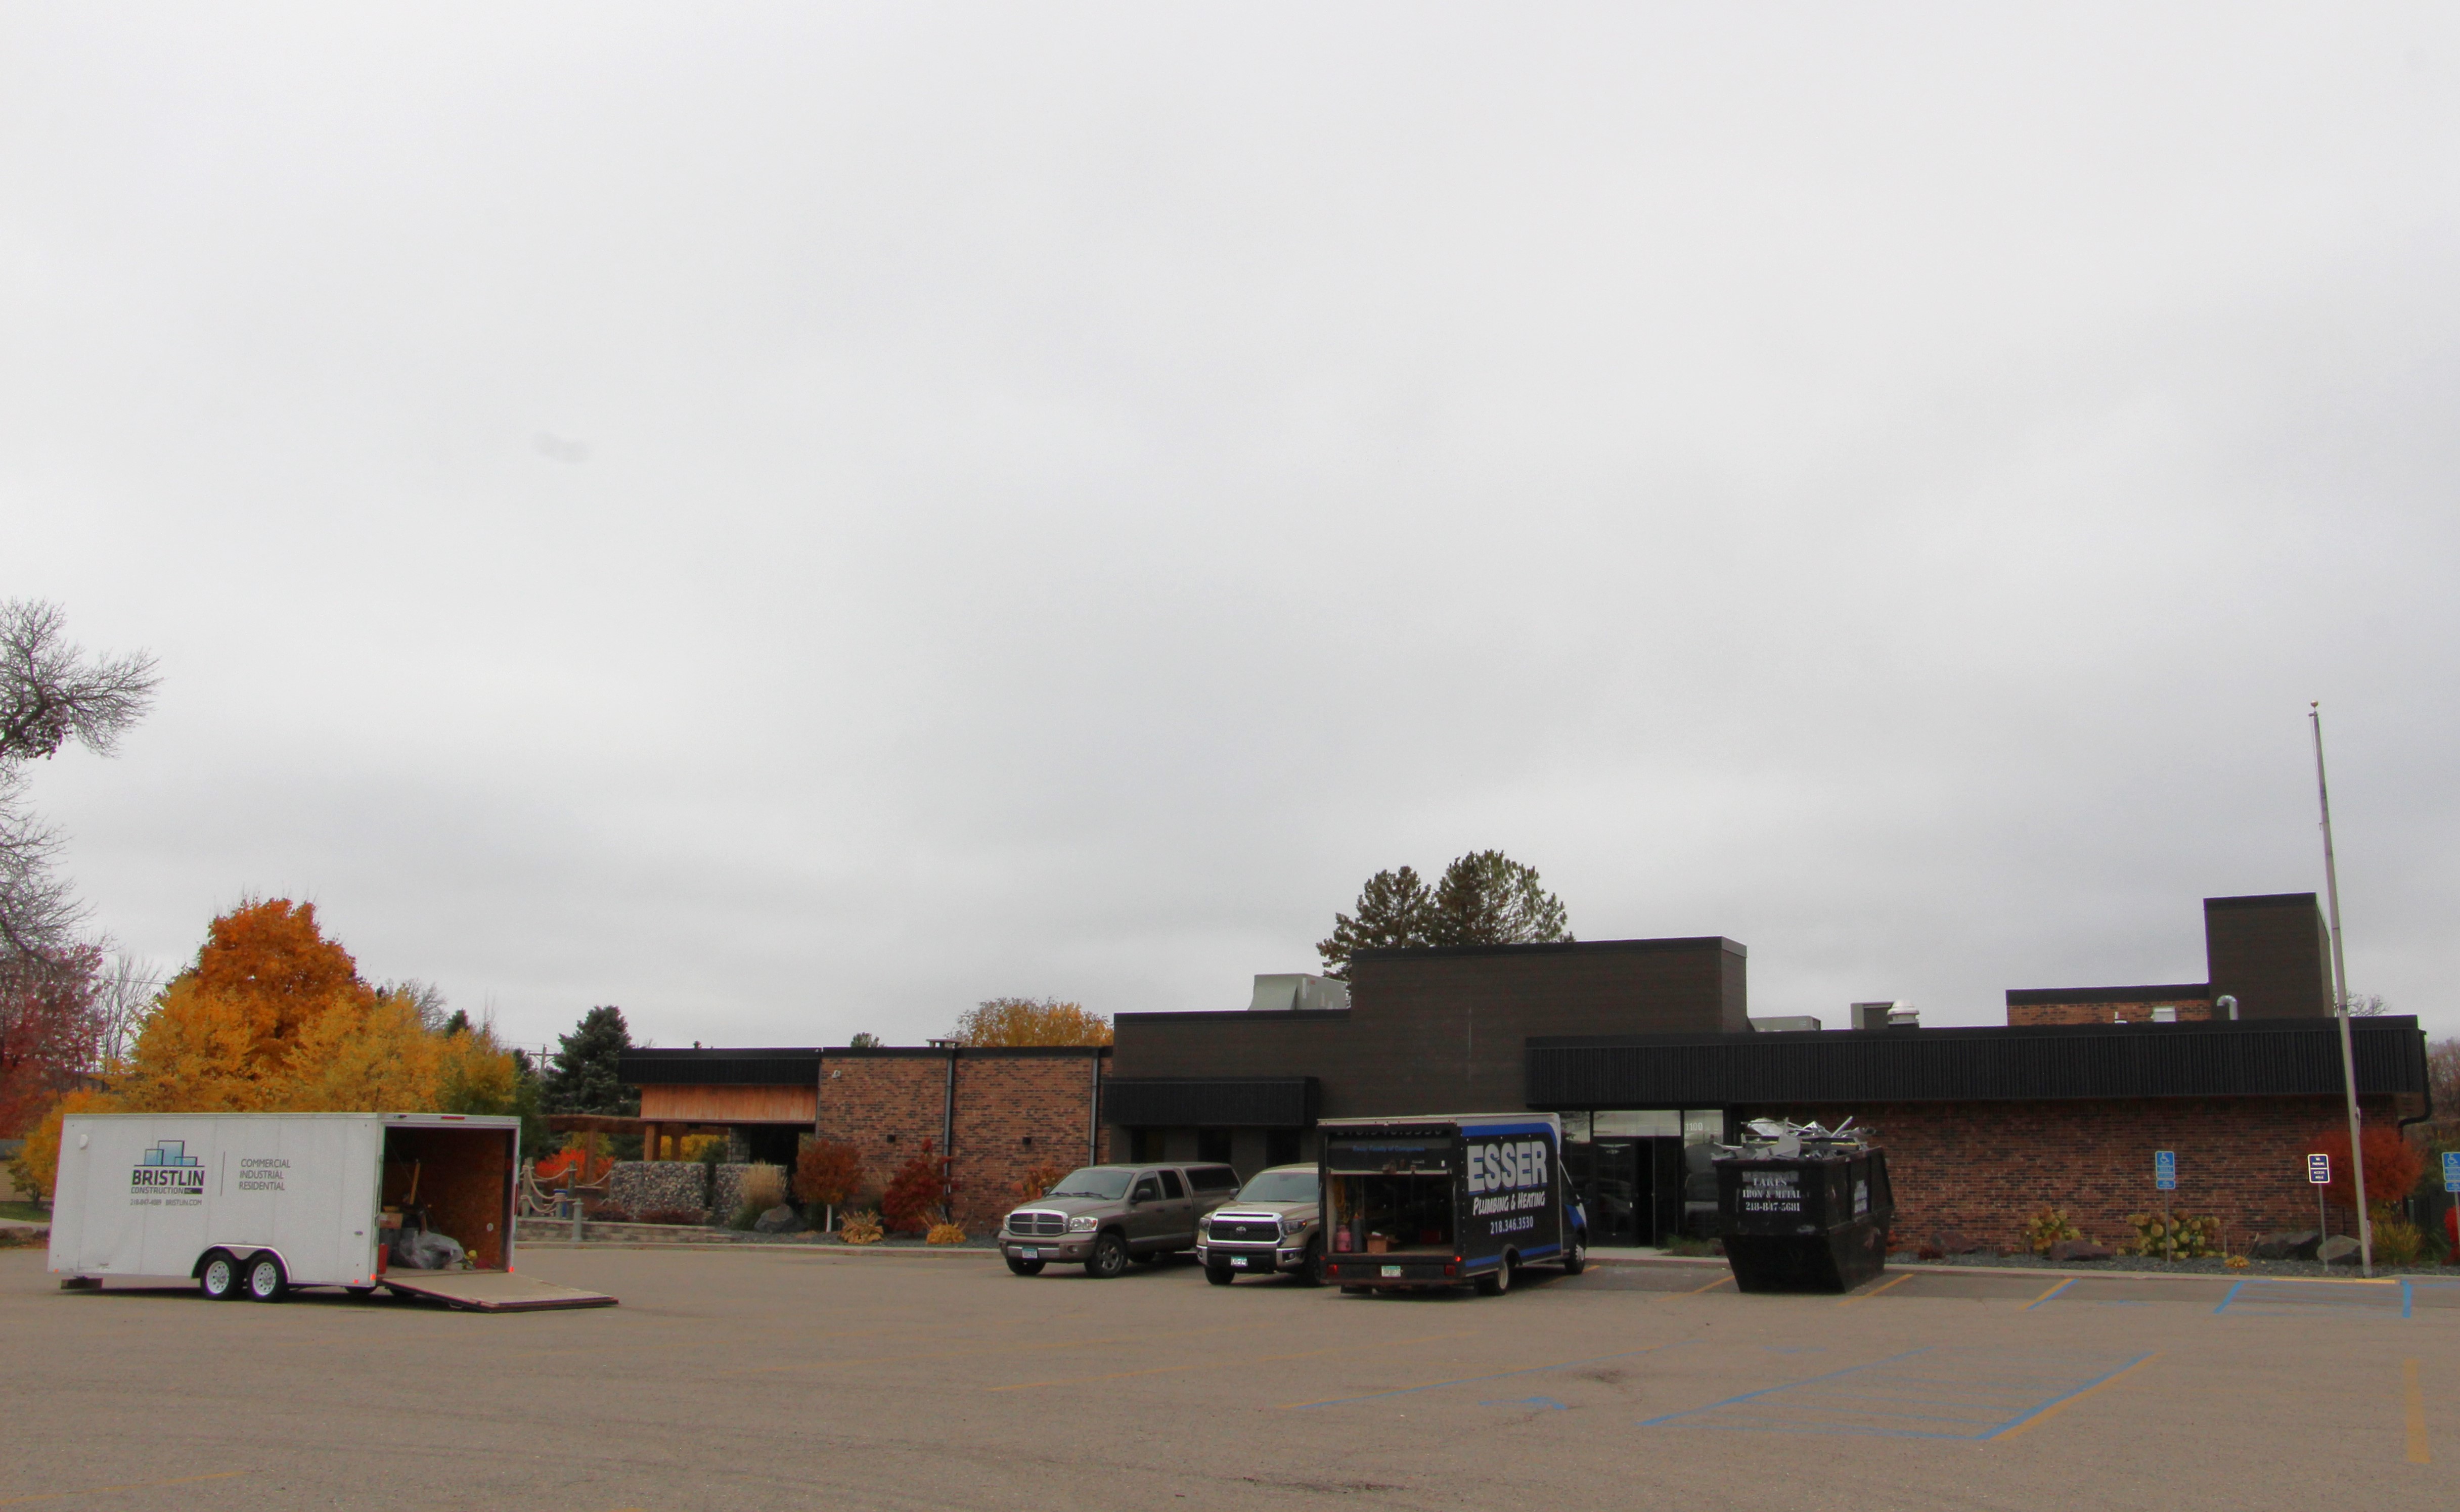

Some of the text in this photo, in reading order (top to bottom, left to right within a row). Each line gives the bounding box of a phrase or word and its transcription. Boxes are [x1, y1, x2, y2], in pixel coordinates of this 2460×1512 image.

[1685, 1122, 1703, 1131] 1100
[241, 1159, 291, 1168] COMMERCIAL
[1467, 1141, 1548, 1195] ESSER
[132, 1169, 205, 1185] BRISTLIN
[240, 1170, 284, 1179] INDUSTRIAL
[239, 1181, 285, 1190] RESIDENTIAL
[1753, 1177, 1787, 1186] LAKES
[1742, 1189, 1763, 1198] IRON
[1775, 1189, 1801, 1199] METAL
[1510, 1194, 1516, 1210] &
[1490, 1216, 1533, 1234] 218.346.3530
